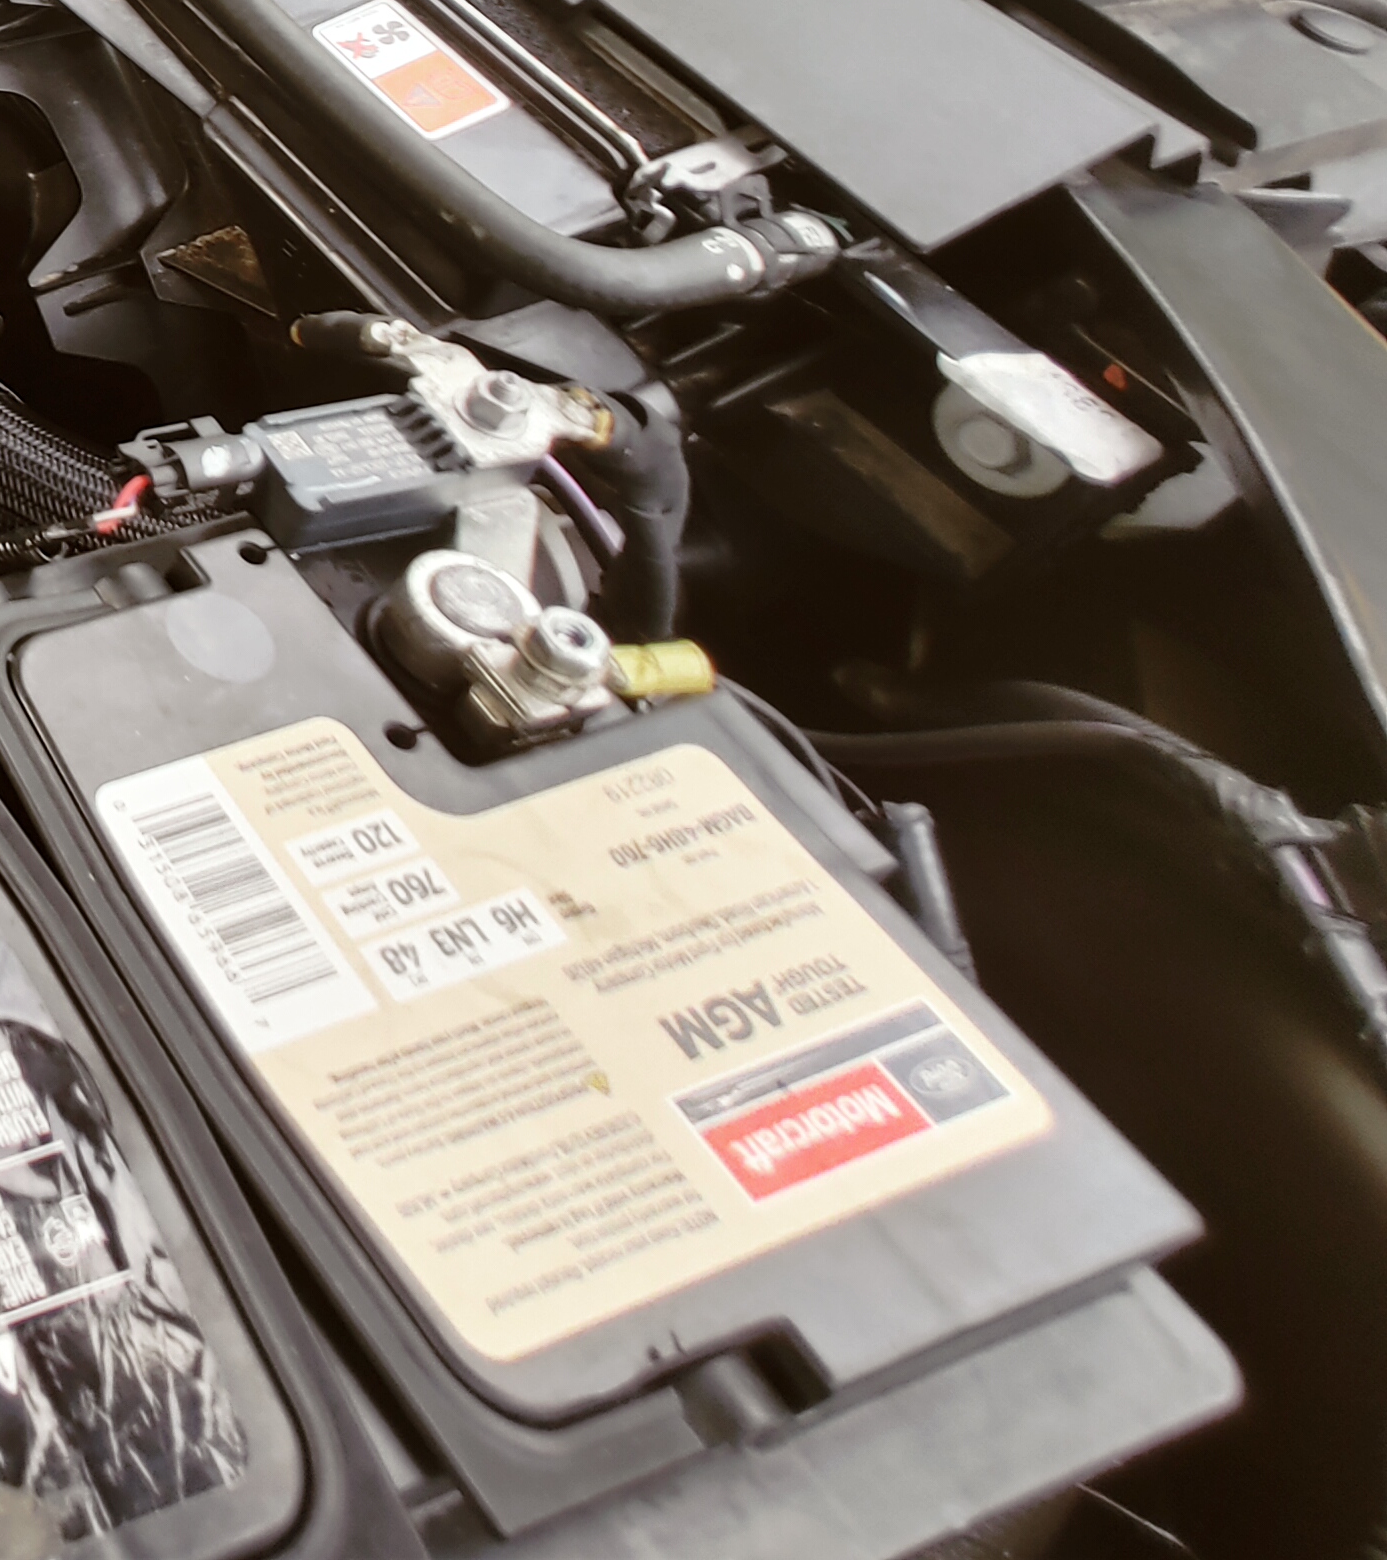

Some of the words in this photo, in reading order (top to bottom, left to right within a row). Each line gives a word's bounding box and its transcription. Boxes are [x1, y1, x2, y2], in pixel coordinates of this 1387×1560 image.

[345, 819, 405, 853] 120
[379, 866, 449, 906] 760
[425, 915, 492, 958] LN3
[486, 898, 541, 936] H6
[376, 939, 429, 977] 48
[655, 981, 794, 1060] AGM
[725, 1082, 908, 1178] Motorcraft
